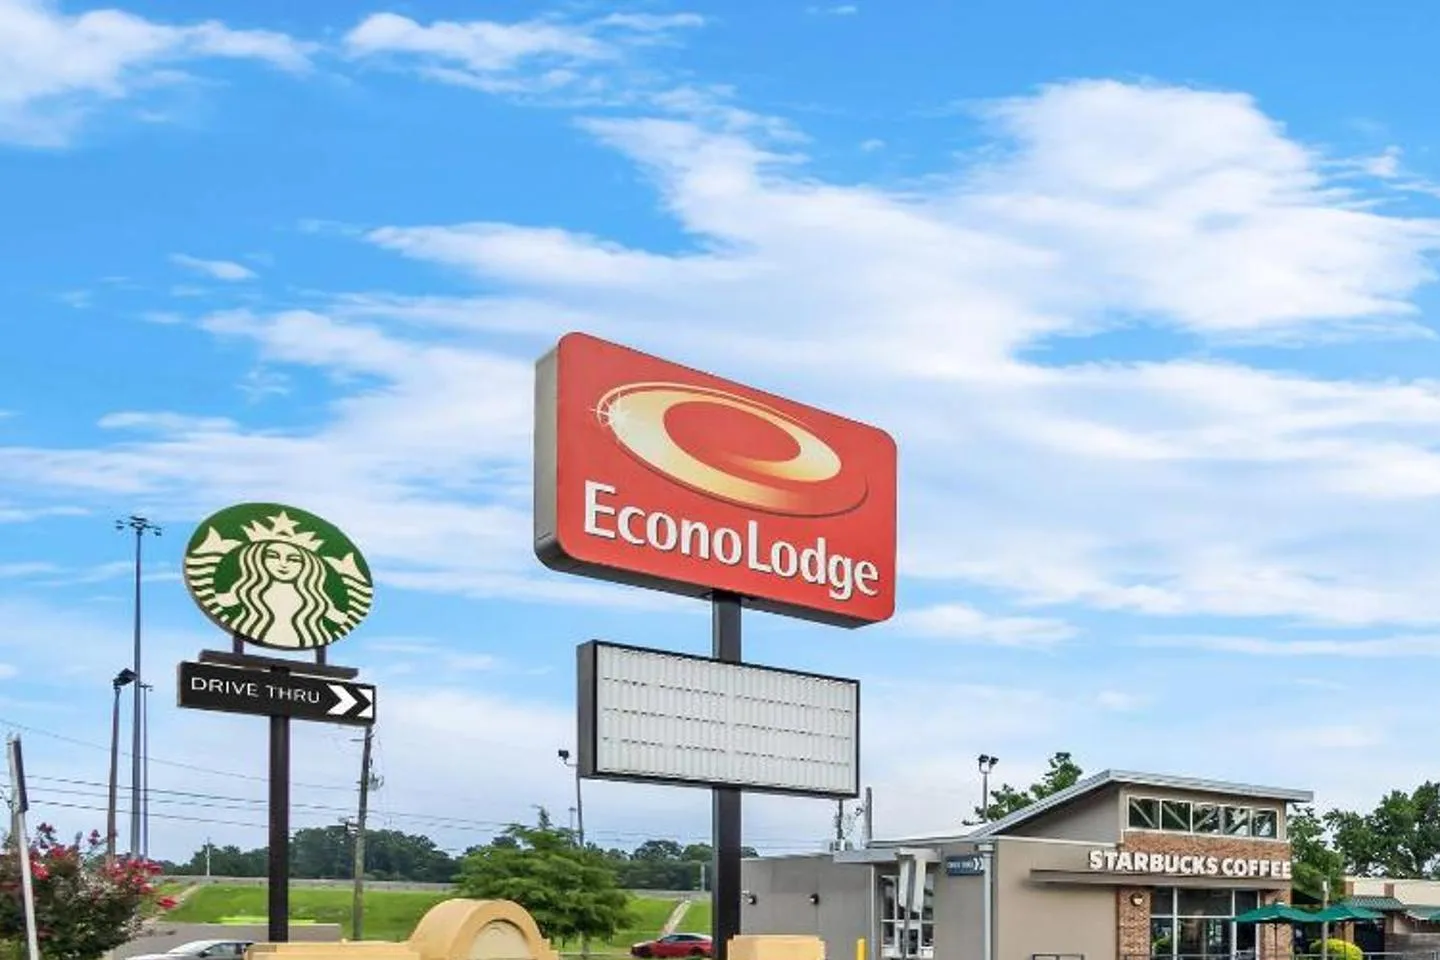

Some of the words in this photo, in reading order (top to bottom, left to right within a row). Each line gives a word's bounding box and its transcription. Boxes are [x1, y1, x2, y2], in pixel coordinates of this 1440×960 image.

[191, 677, 259, 697] DRIVE
[265, 684, 320, 704] THRU
[1089, 850, 1219, 875] STARBUCKS
[1221, 858, 1292, 880] COFFEE
